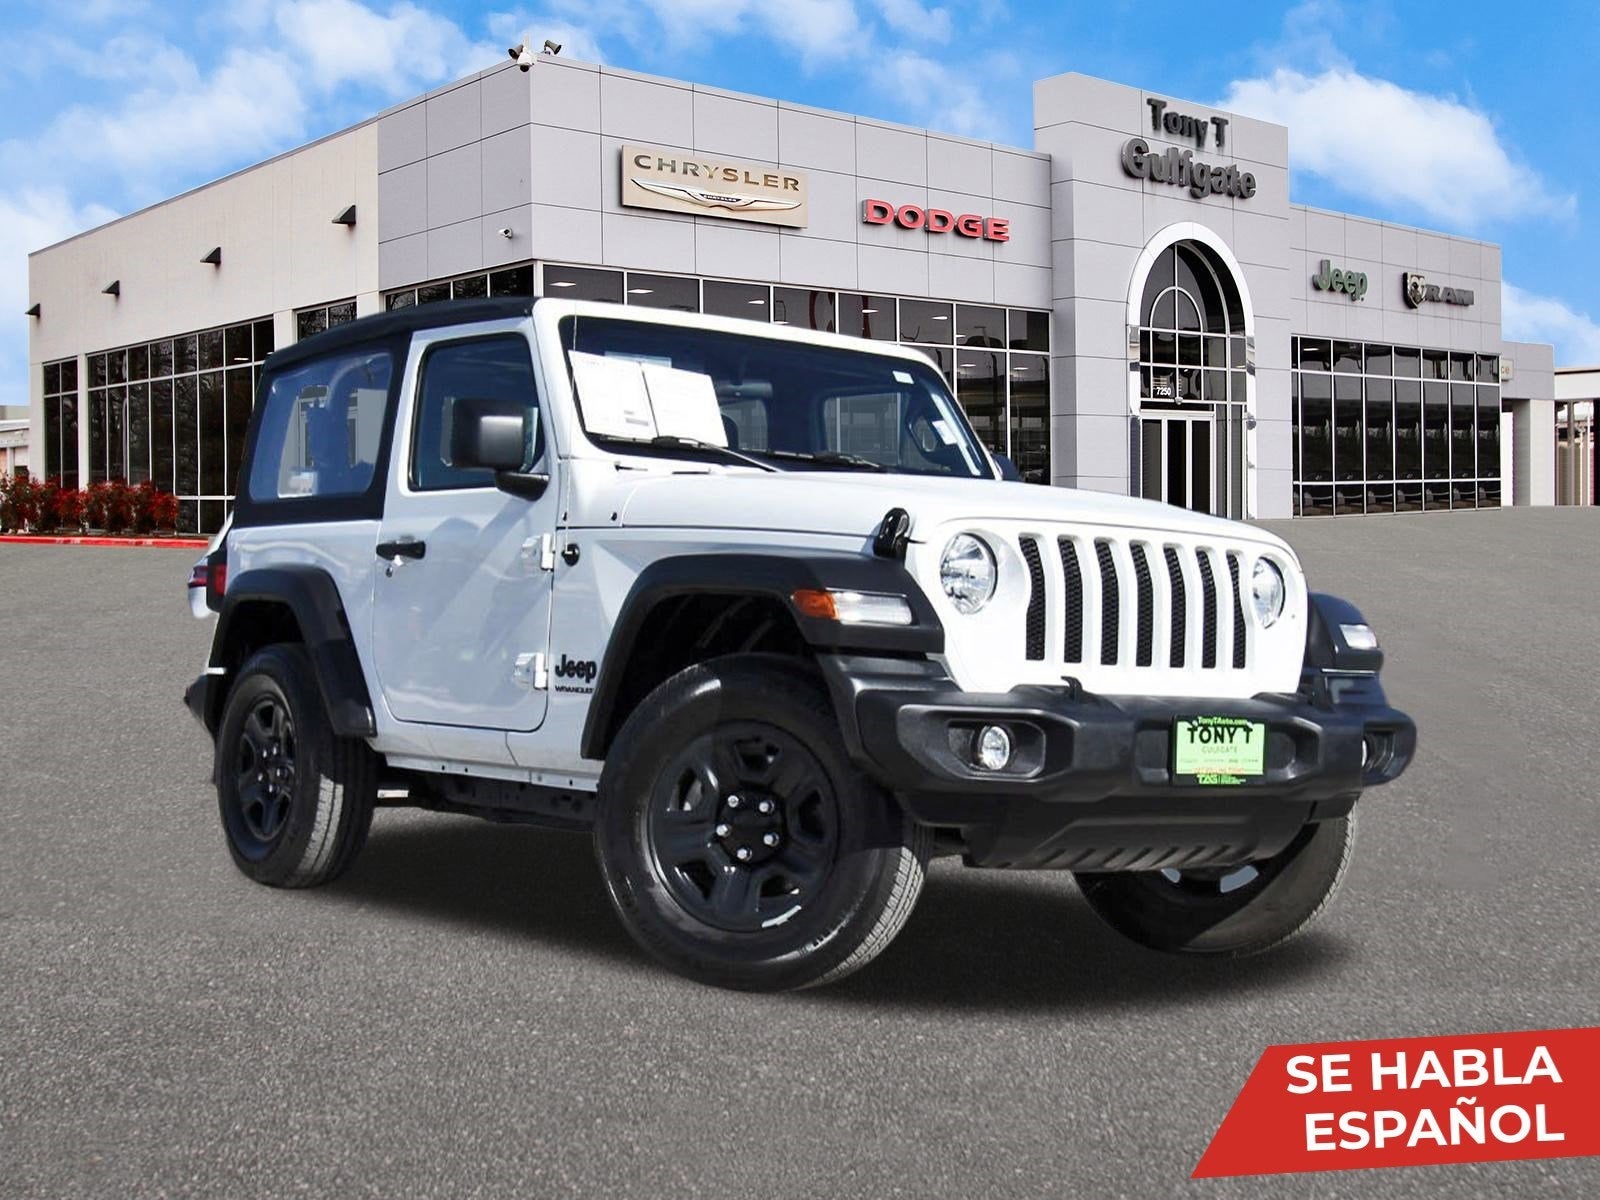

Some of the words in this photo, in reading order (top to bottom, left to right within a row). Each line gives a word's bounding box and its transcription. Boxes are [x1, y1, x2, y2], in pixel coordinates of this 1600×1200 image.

[1146, 98, 1208, 148] Tony
[1210, 116, 1229, 148] T
[633, 154, 799, 191] CHRYSLER
[1120, 138, 1256, 199] Gulfgate
[862, 199, 1010, 242] DODGE
[1312, 259, 1368, 302] Jeep
[1425, 284, 1475, 306] RAM
[555, 654, 597, 684] Jeep
[1187, 726, 1237, 744] TONY
[1243, 726, 1253, 744] T
